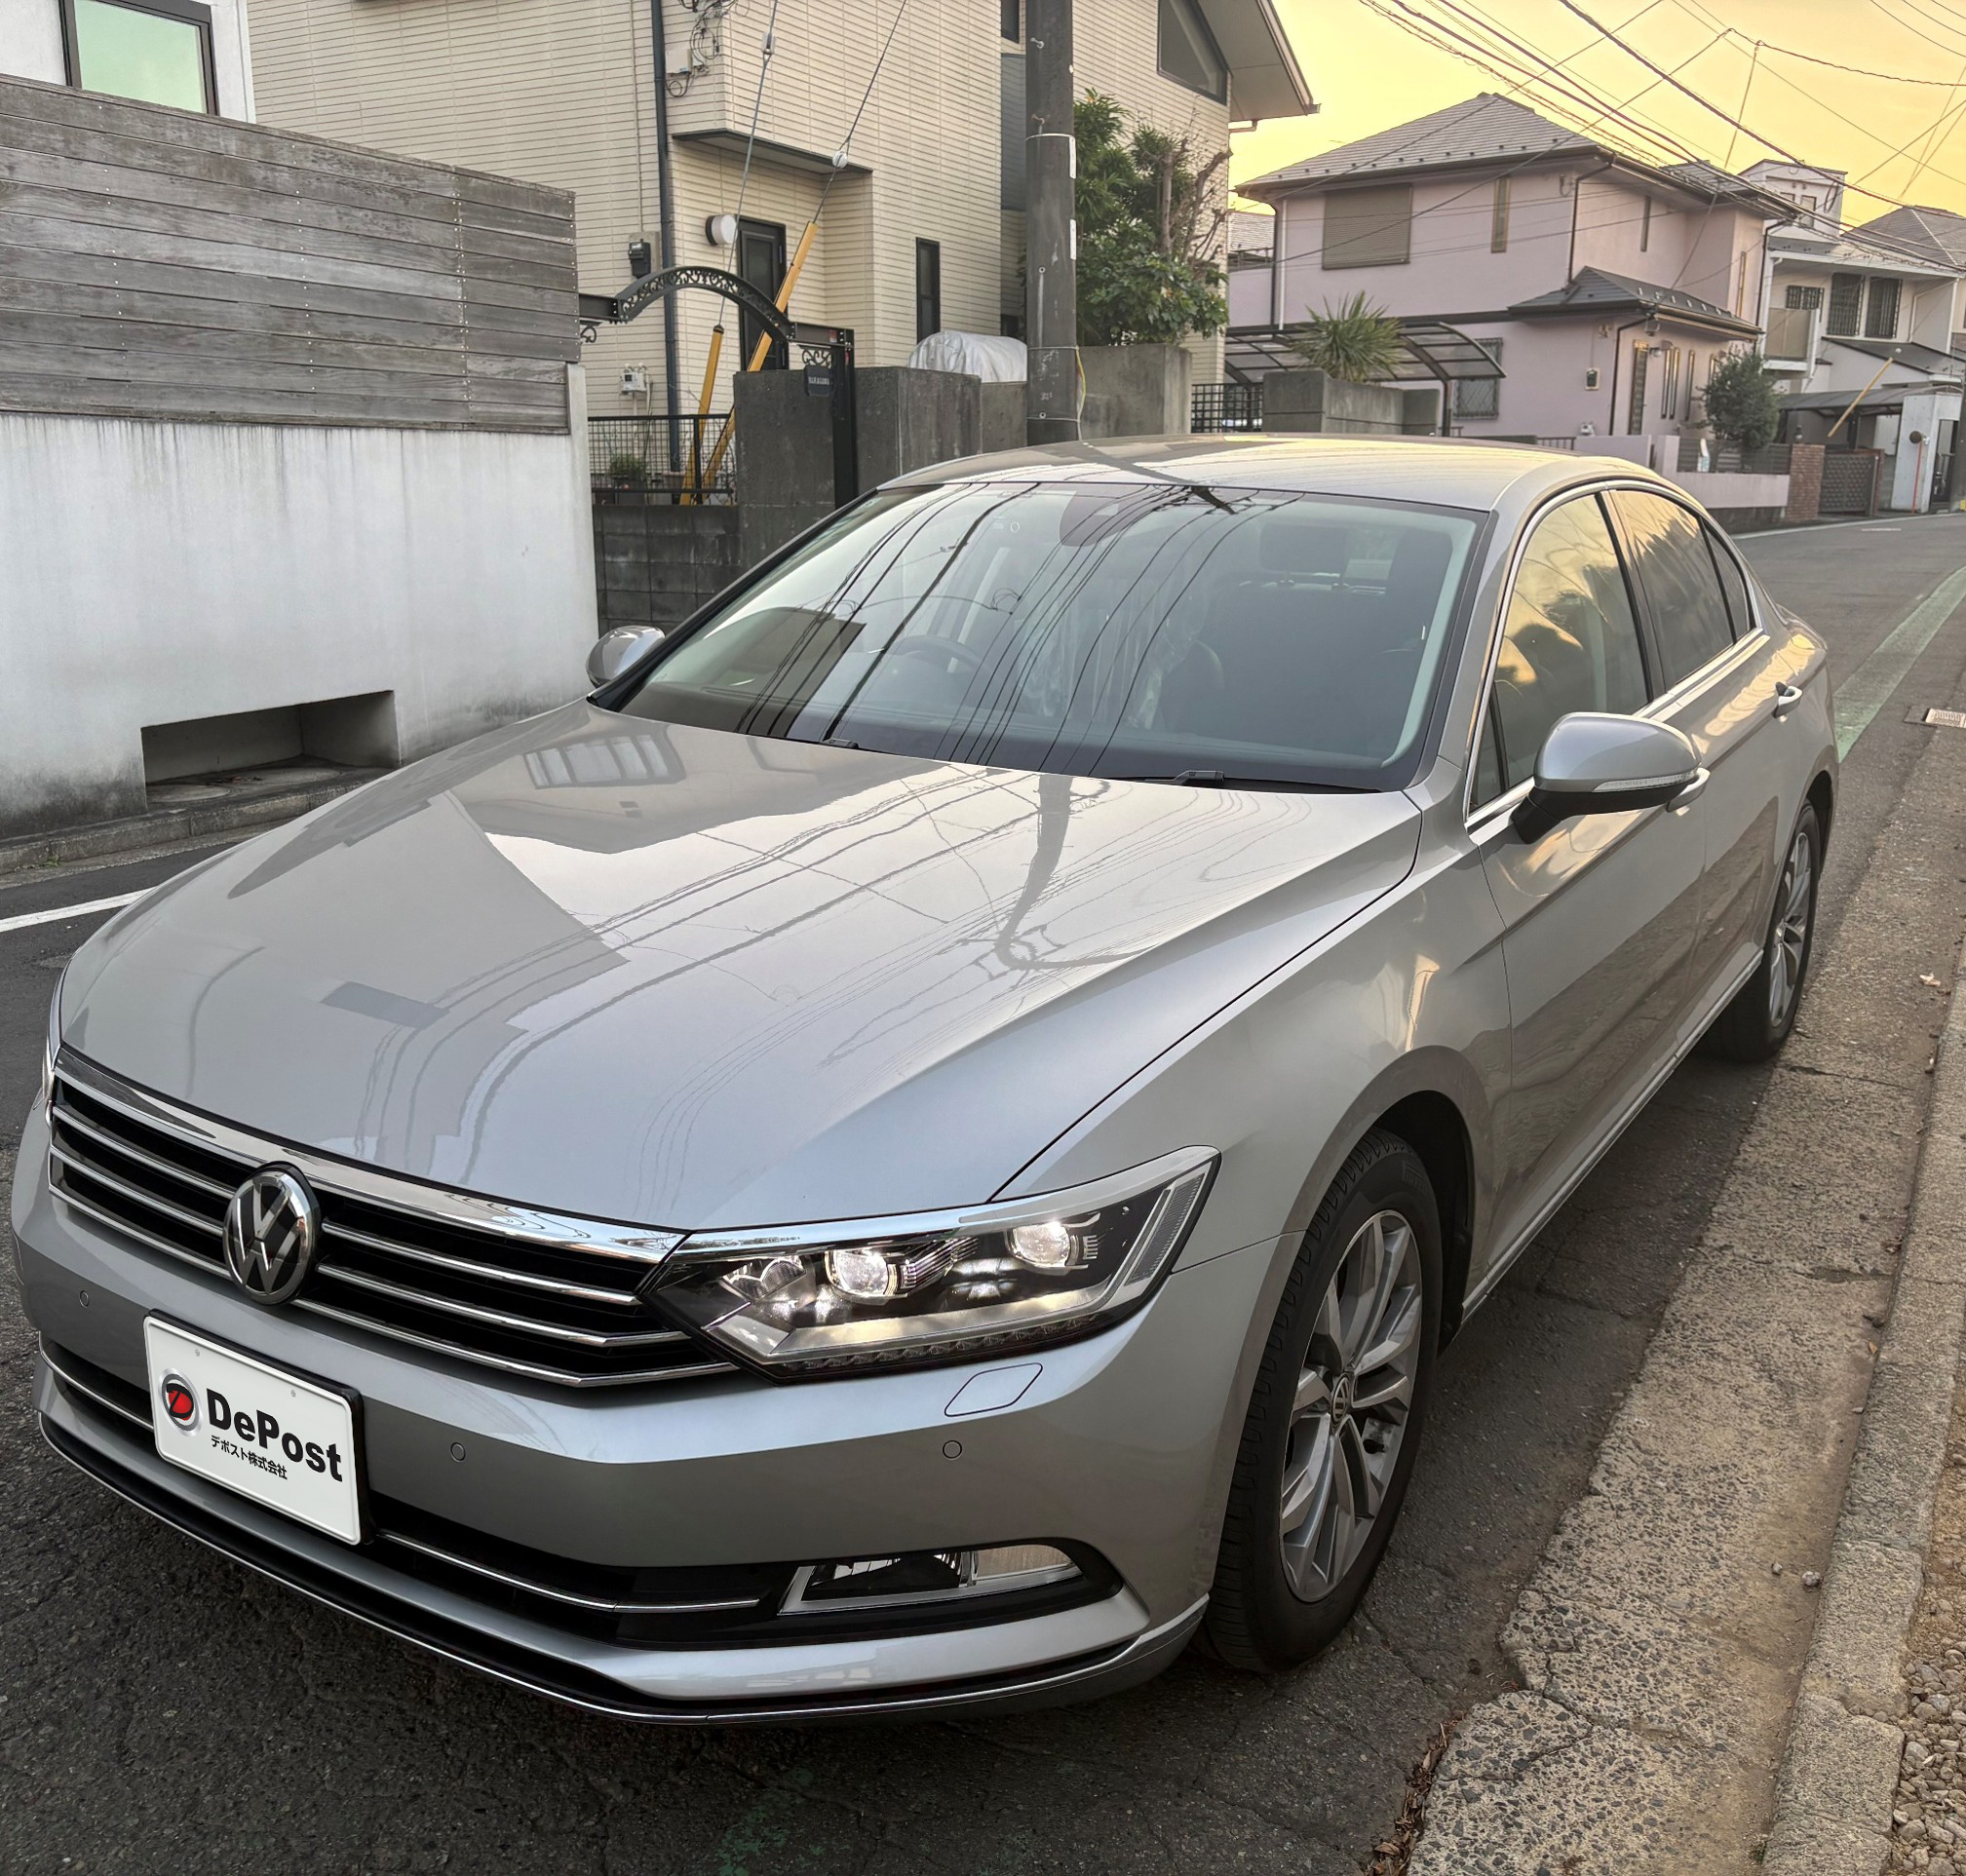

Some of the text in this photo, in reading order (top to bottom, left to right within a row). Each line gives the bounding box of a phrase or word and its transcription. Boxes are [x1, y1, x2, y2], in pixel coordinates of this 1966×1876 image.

[206, 1388, 343, 1482] DePost
[211, 1435, 288, 1480] デポスト株式会社
